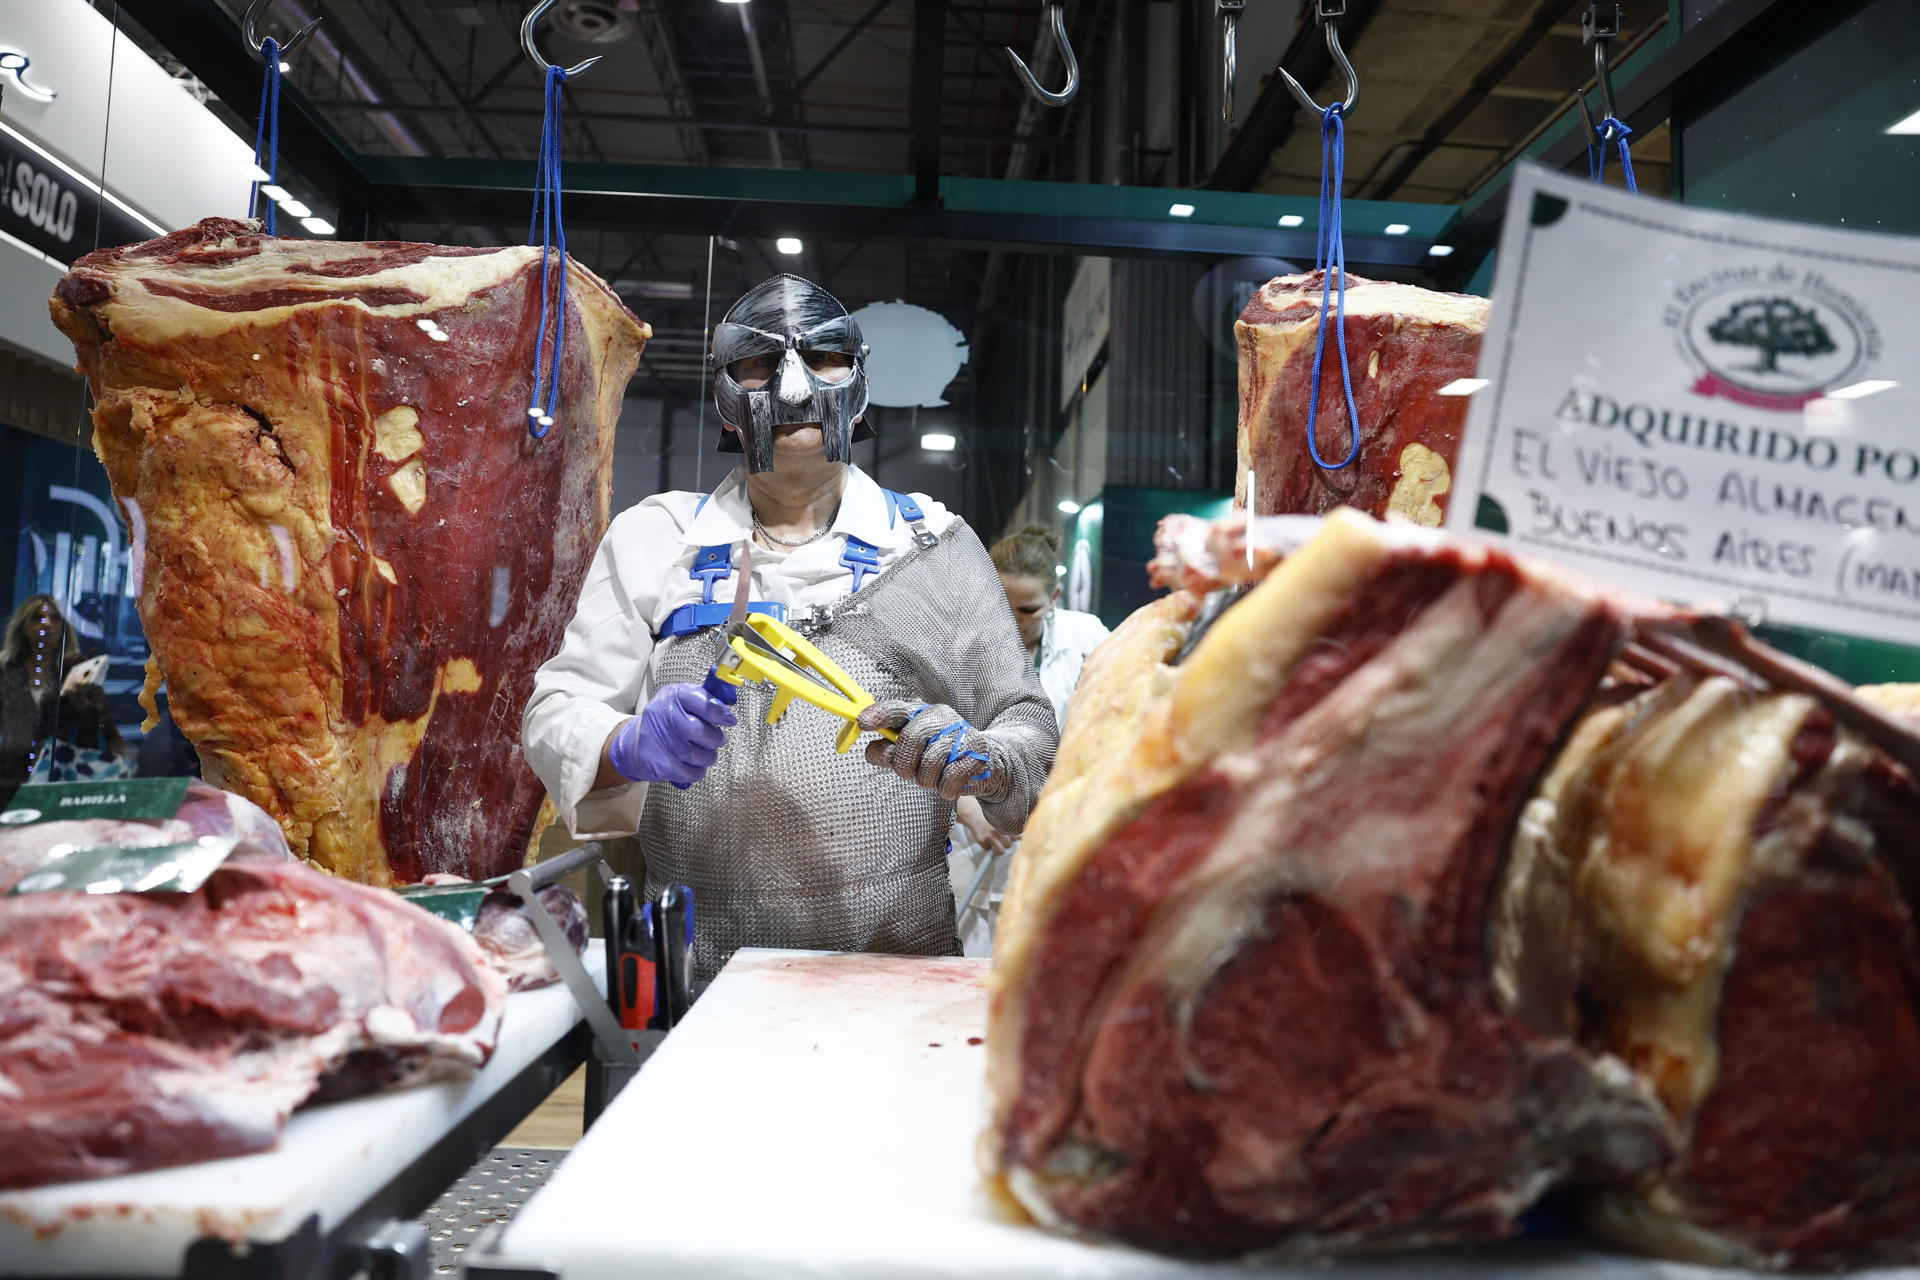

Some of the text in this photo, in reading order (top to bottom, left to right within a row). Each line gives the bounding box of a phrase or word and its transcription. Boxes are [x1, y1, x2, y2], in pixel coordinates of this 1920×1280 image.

[13, 161, 78, 243] SOLO
[1767, 262, 1797, 285] de
[1511, 428, 1559, 481] EL
[1554, 389, 1839, 471] ADQUIRIDO
[1526, 490, 1691, 561] BUENOS
